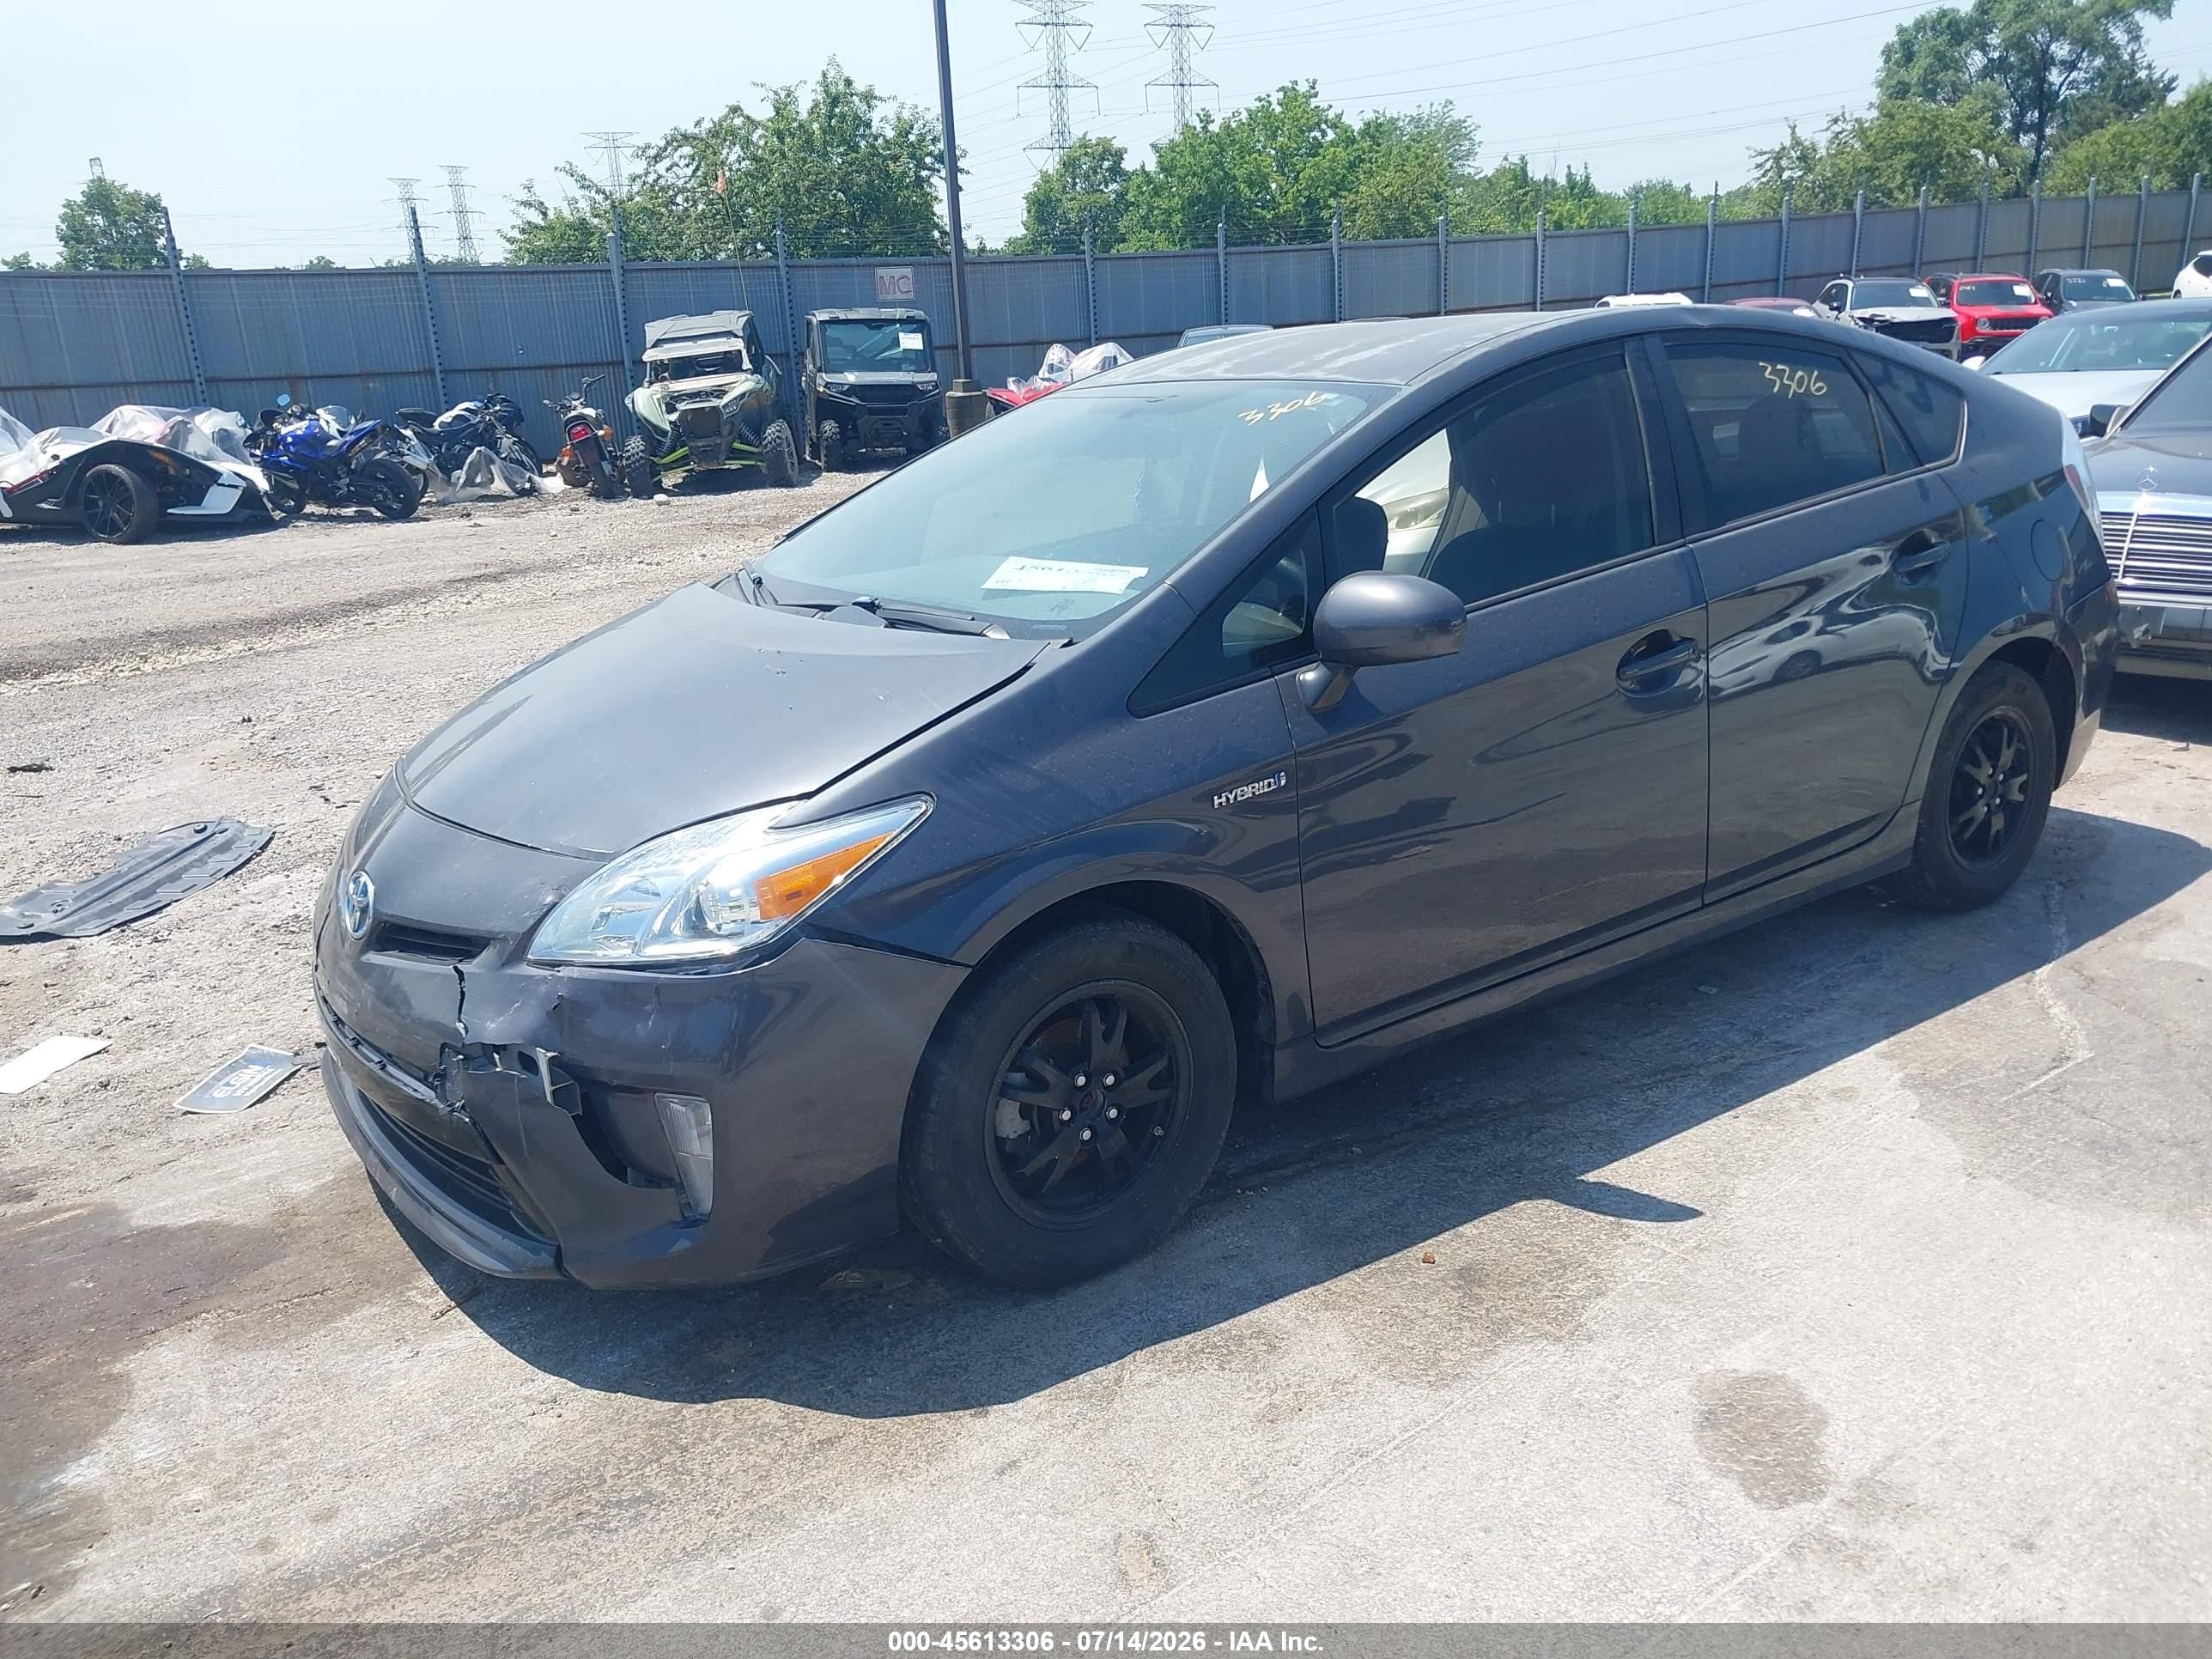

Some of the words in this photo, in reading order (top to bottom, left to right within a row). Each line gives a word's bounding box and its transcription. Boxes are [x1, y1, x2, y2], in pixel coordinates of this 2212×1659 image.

[878, 276, 913, 295] MC
[1759, 362, 1827, 398] 3306
[1213, 778, 1277, 809] HYBRID
[212, 1064, 265, 1098] ELGIN
